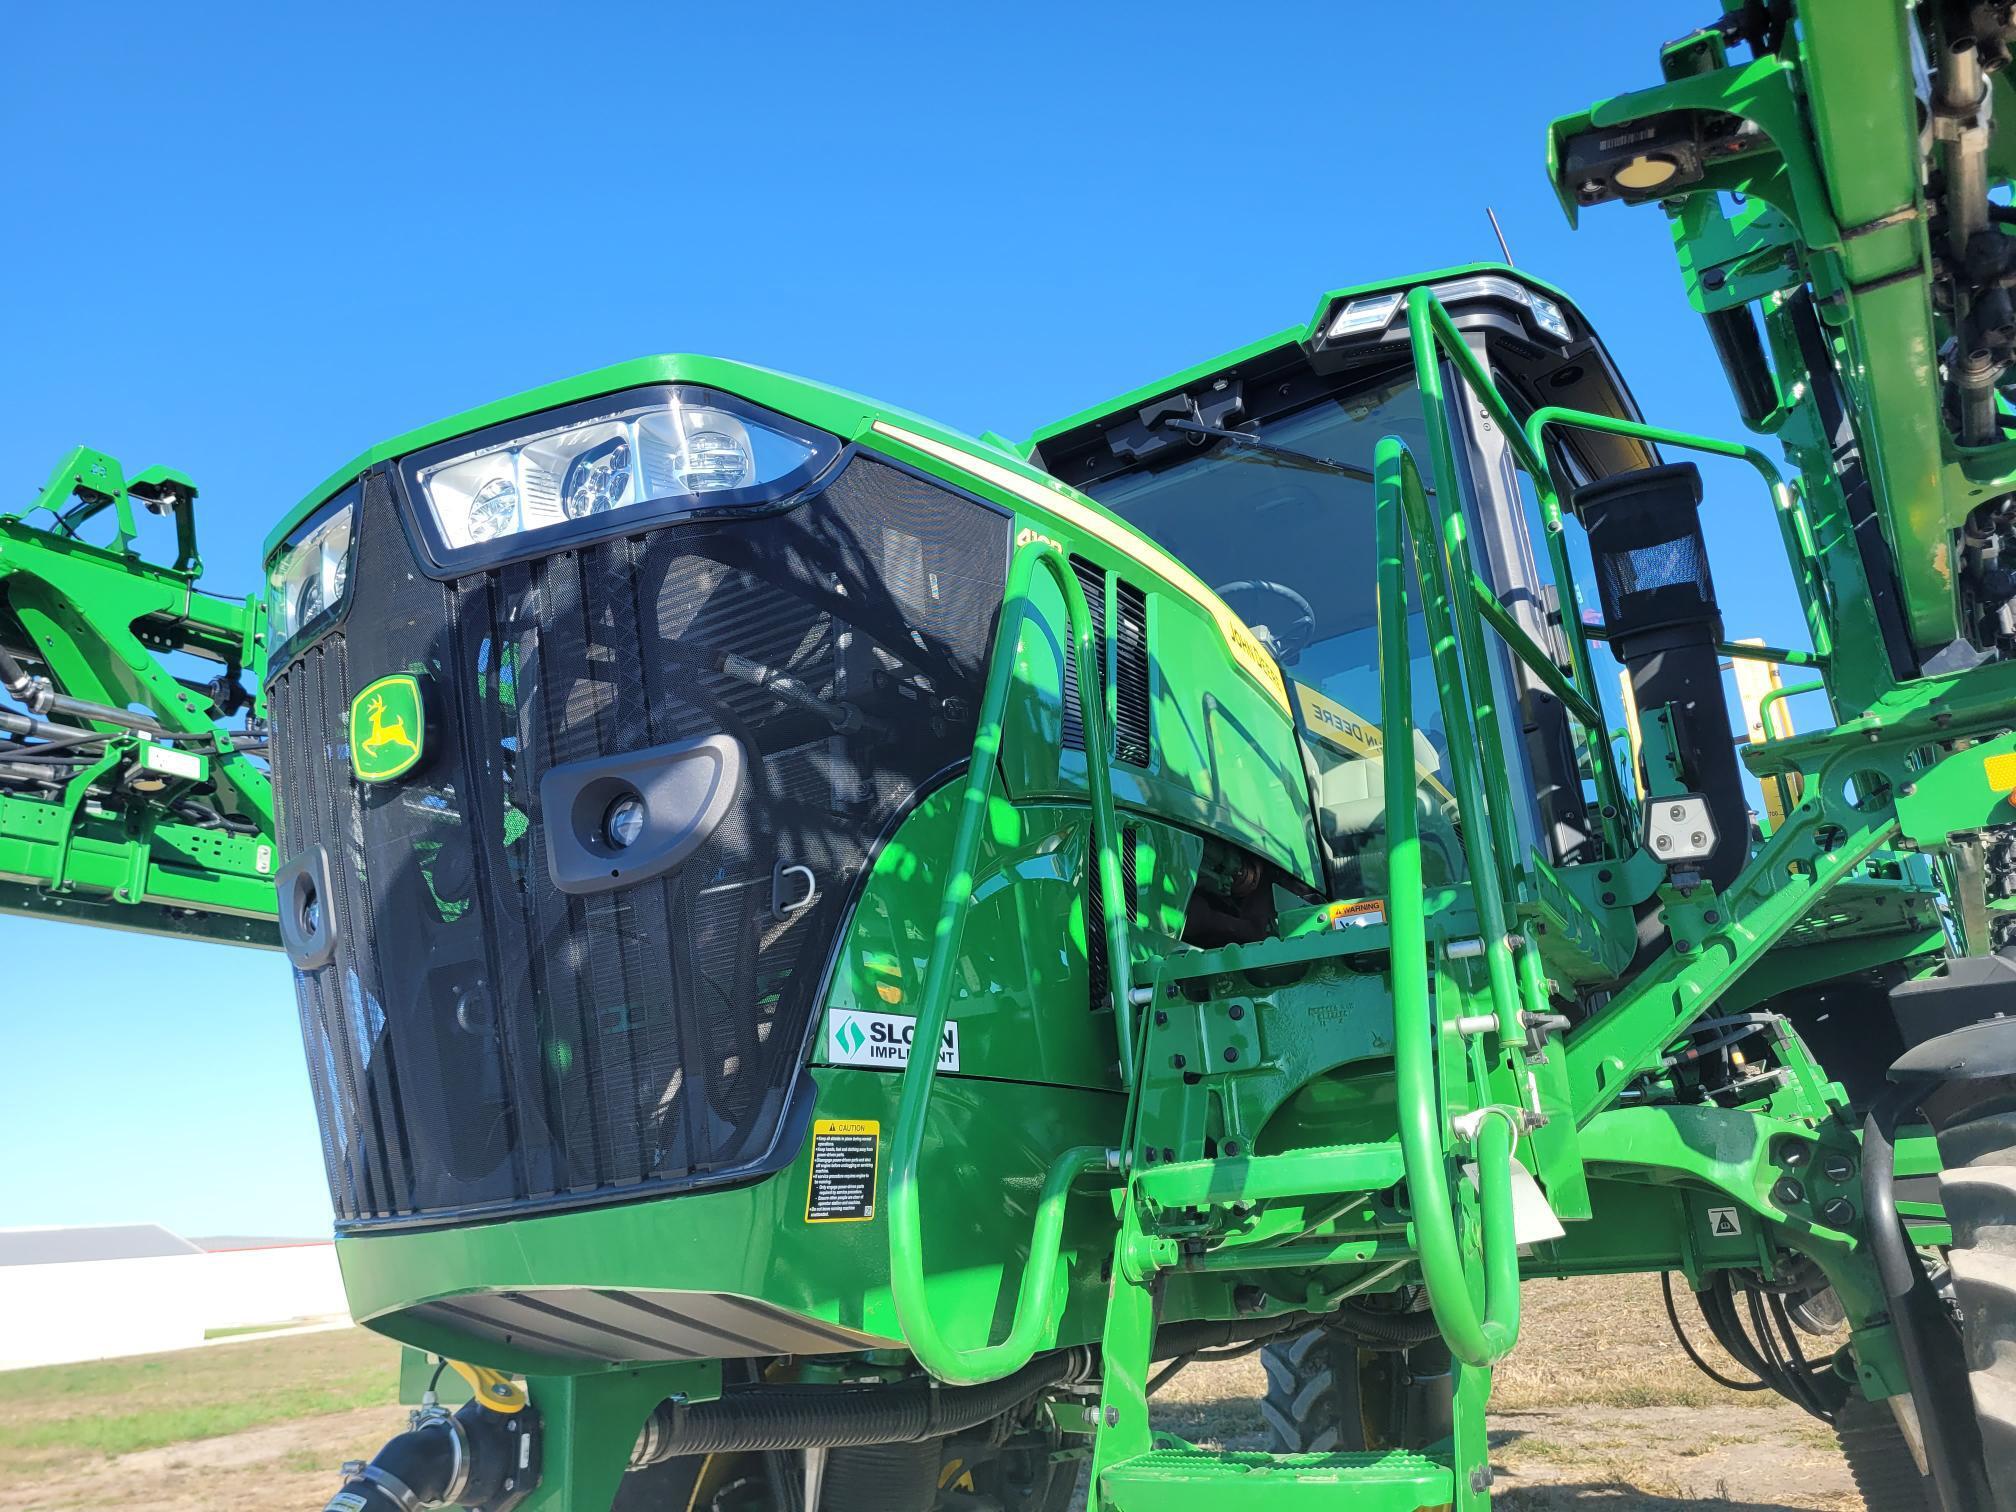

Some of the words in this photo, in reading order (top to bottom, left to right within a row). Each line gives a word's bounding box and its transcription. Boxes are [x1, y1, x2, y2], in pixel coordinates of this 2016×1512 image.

[1344, 902, 1380, 914] WARNING
[870, 1022, 954, 1048] SLON
[870, 1046, 954, 1063] IMPLNT
[838, 1124, 864, 1132] CAUTION
